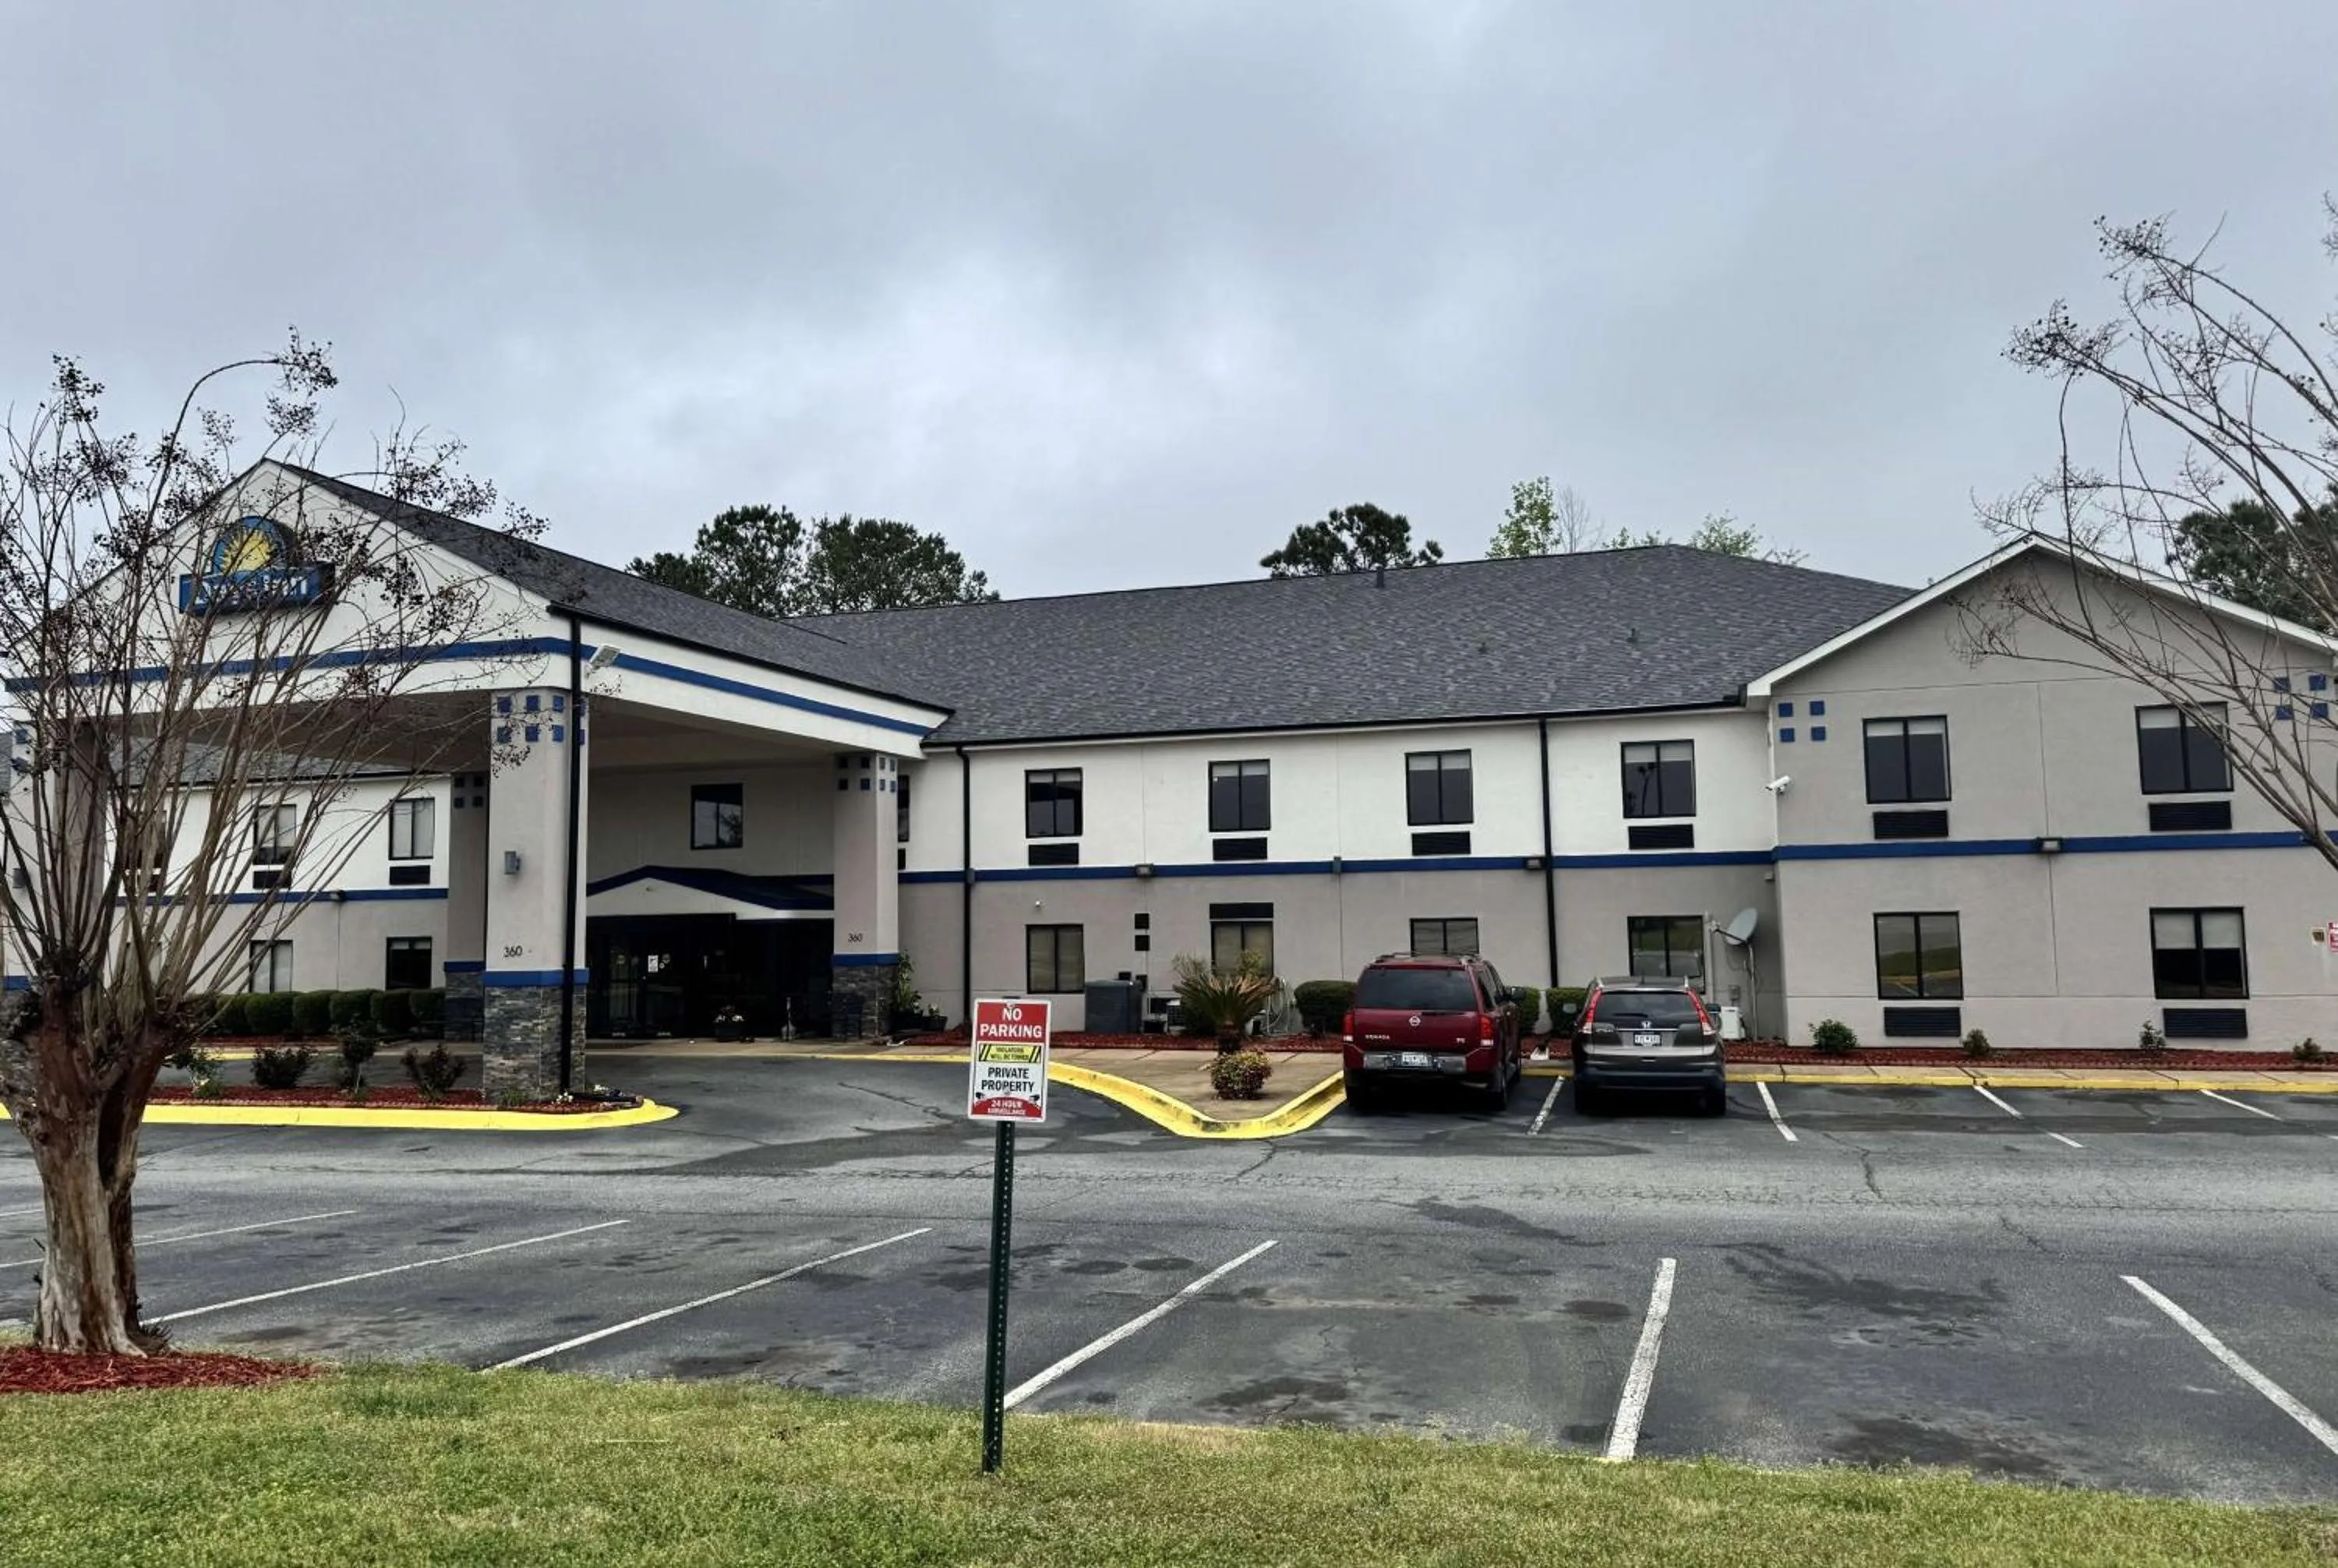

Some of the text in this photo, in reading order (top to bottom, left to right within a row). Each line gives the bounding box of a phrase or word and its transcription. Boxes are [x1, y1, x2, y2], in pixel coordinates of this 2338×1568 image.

[503, 945, 523, 958] 360
[1002, 1008, 1022, 1022] NO
[980, 1023, 1042, 1039] PARKING
[987, 1067, 1029, 1079] PRIVATE
[981, 1080, 1036, 1093] PROPERTY
